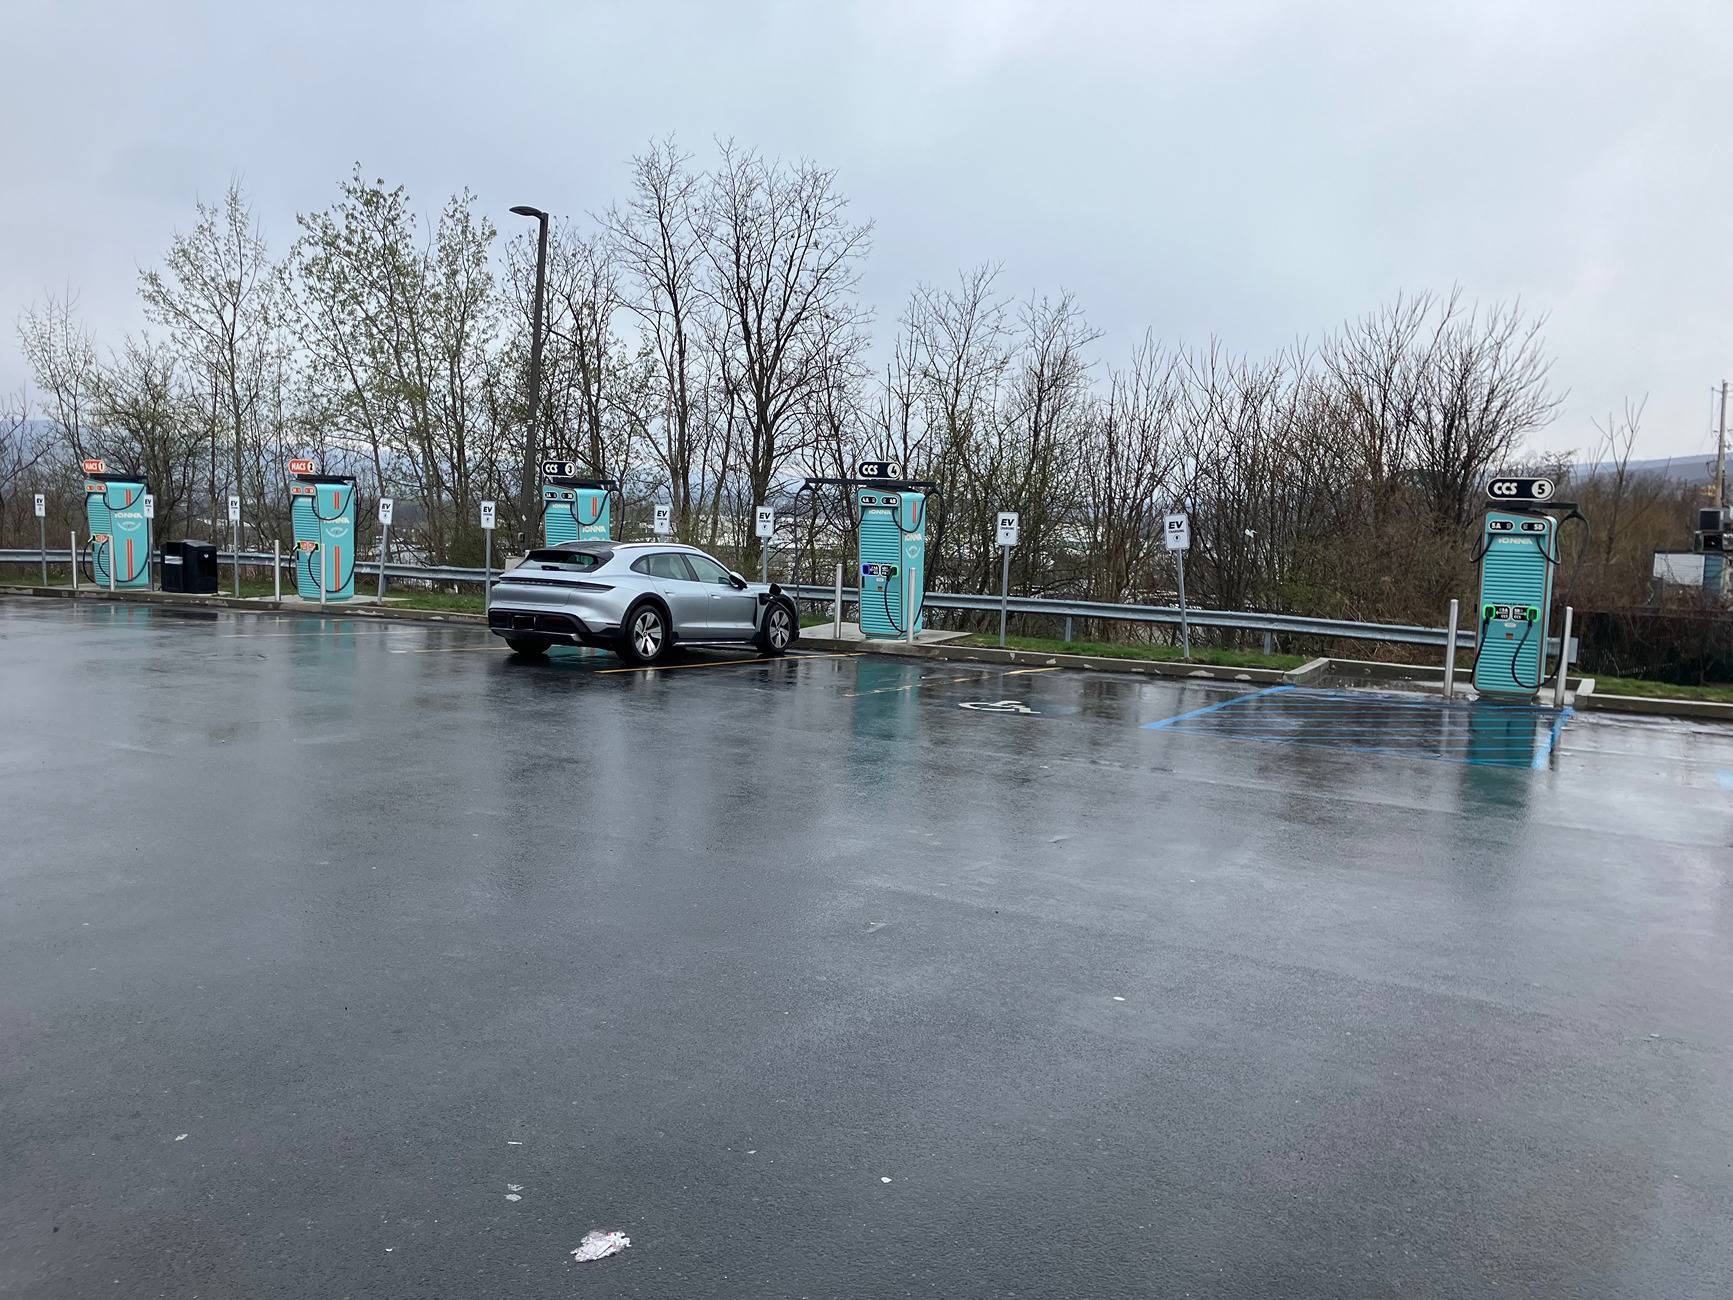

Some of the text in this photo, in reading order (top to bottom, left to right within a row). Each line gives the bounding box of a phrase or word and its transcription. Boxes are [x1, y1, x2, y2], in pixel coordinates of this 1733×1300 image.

[291, 462, 306, 470] NACS
[545, 464, 557, 473] CCS
[863, 465, 897, 475] CCS 4
[1493, 482, 1545, 495] CCS 5
[582, 525, 606, 533] IONNA
[1168, 521, 1183, 529] EV
